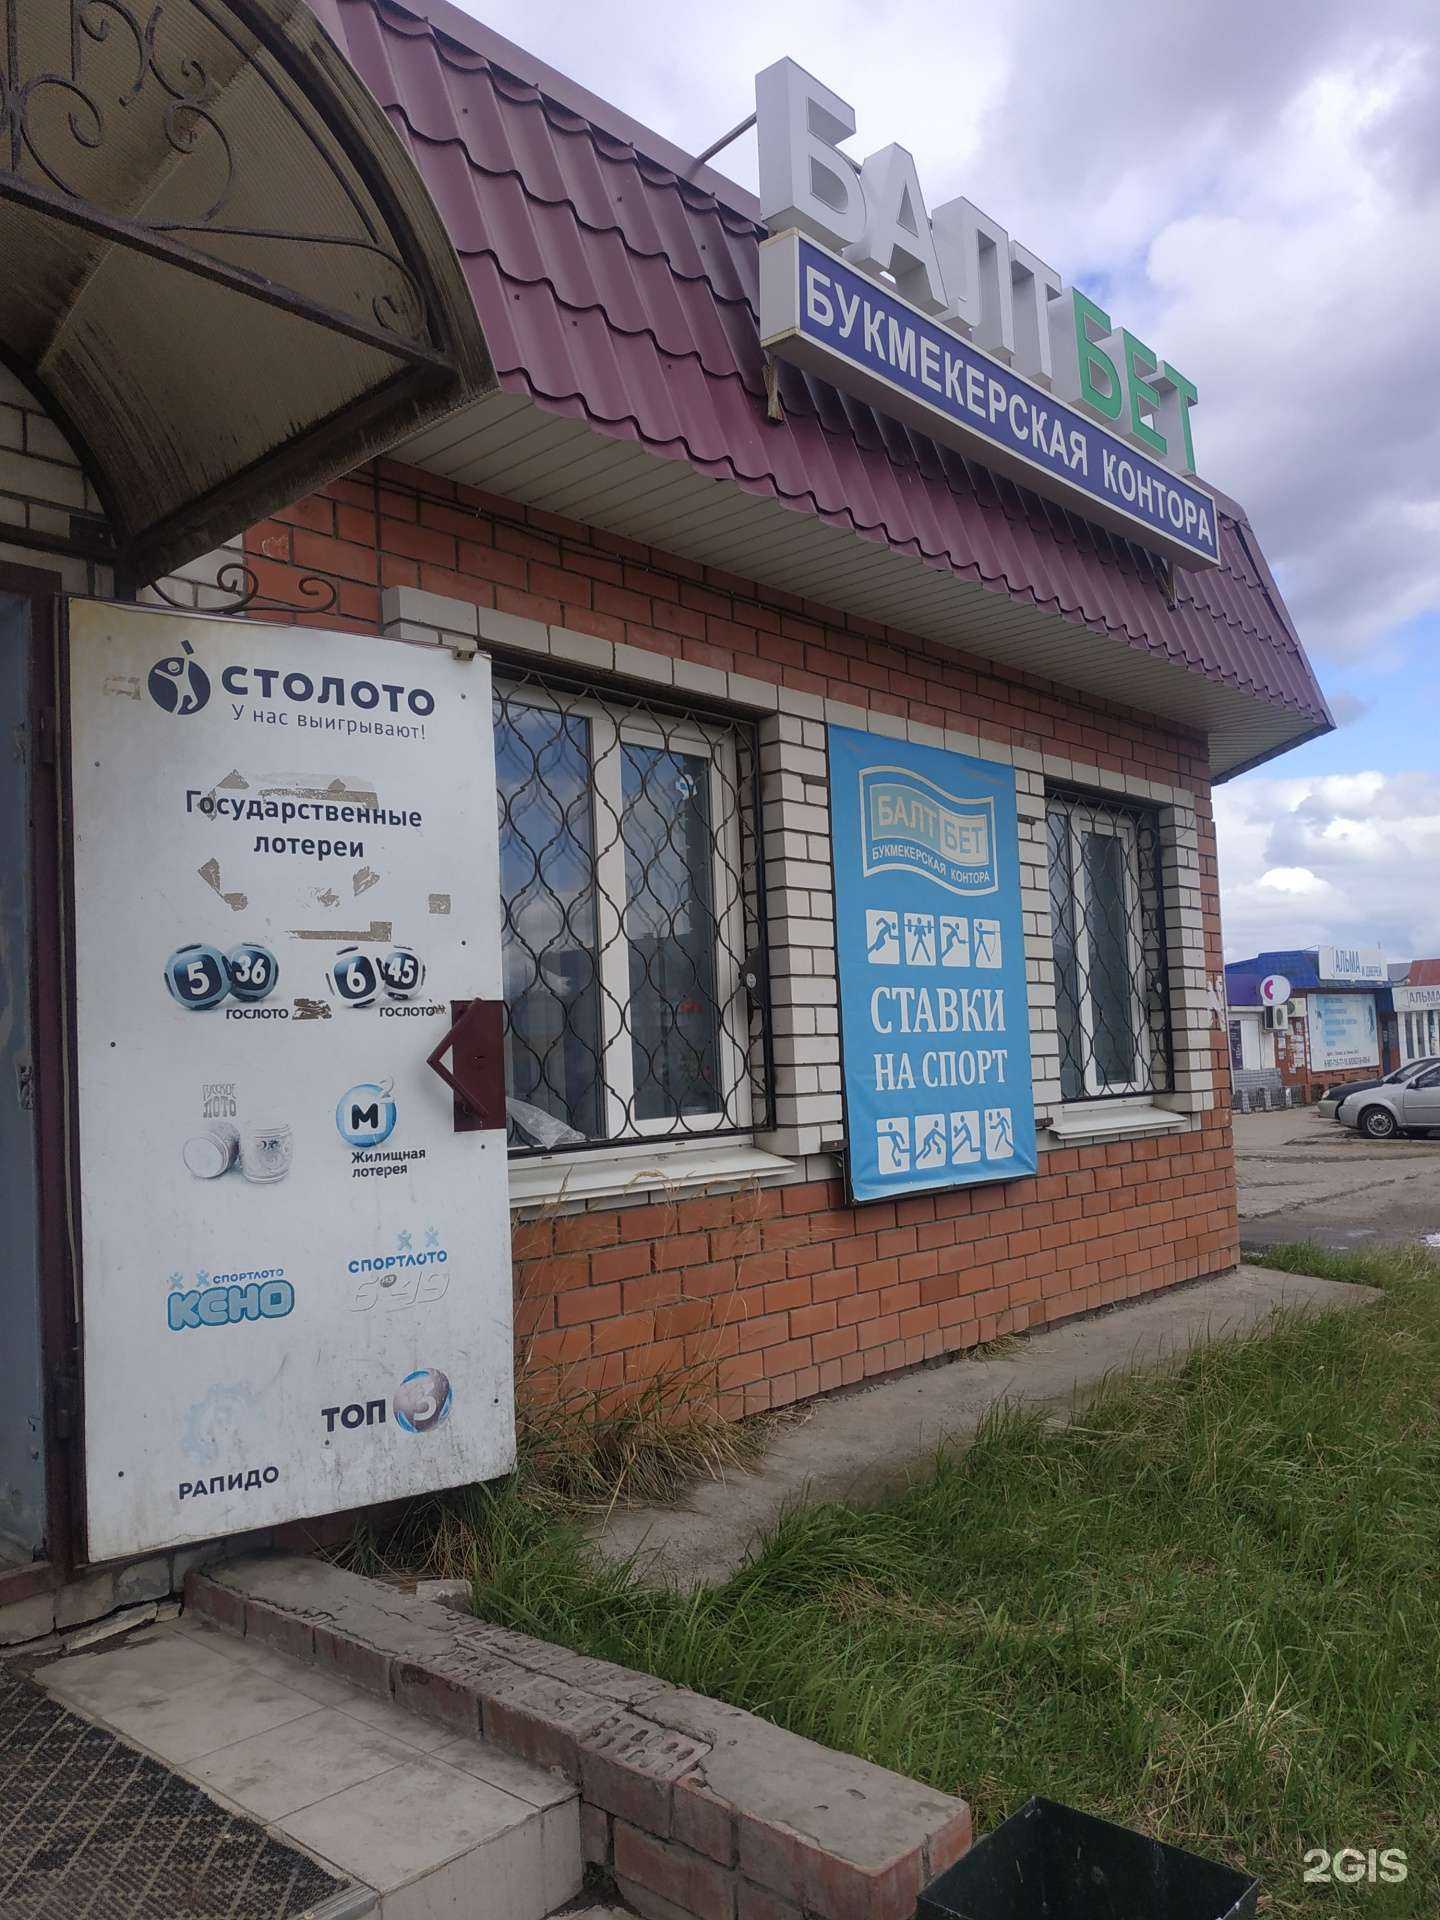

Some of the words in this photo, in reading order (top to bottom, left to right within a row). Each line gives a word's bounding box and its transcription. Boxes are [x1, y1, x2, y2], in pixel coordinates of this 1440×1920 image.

[805, 264, 1088, 477] БУКМЕКЕРСКАЯ
[1102, 447, 1214, 547] КОНТОРА
[221, 664, 436, 717] СТОЛОТО
[231, 704, 245, 721] У
[253, 710, 288, 726] нас
[297, 713, 427, 741] выигрывают!
[185, 790, 423, 828] Государственные
[253, 836, 365, 860] лотереи
[872, 843, 947, 876] БУКМЕКЕРСКАЯ
[950, 867, 991, 884] КОНТОРА
[187, 960, 210, 995] 5
[236, 955, 266, 985] 36
[346, 963, 367, 994] 6
[388, 957, 415, 984] 45
[1335, 950, 1361, 973] АЛЬМА
[226, 1007, 289, 1020] ГОСЛОТО
[379, 1006, 435, 1018] ГОСЛОТО
[871, 986, 1006, 1034] СТАВКИ
[874, 1052, 917, 1092] НА
[921, 1049, 1008, 1089] СПОРТ
[351, 1148, 427, 1165] Жилищная
[352, 1162, 408, 1178] лотерея
[212, 1268, 284, 1284] СПОРТЛОТО
[348, 1250, 448, 1273] СПОРТЛОТО
[321, 1398, 386, 1432] ТОП
[178, 1465, 280, 1501] РАПИДО
